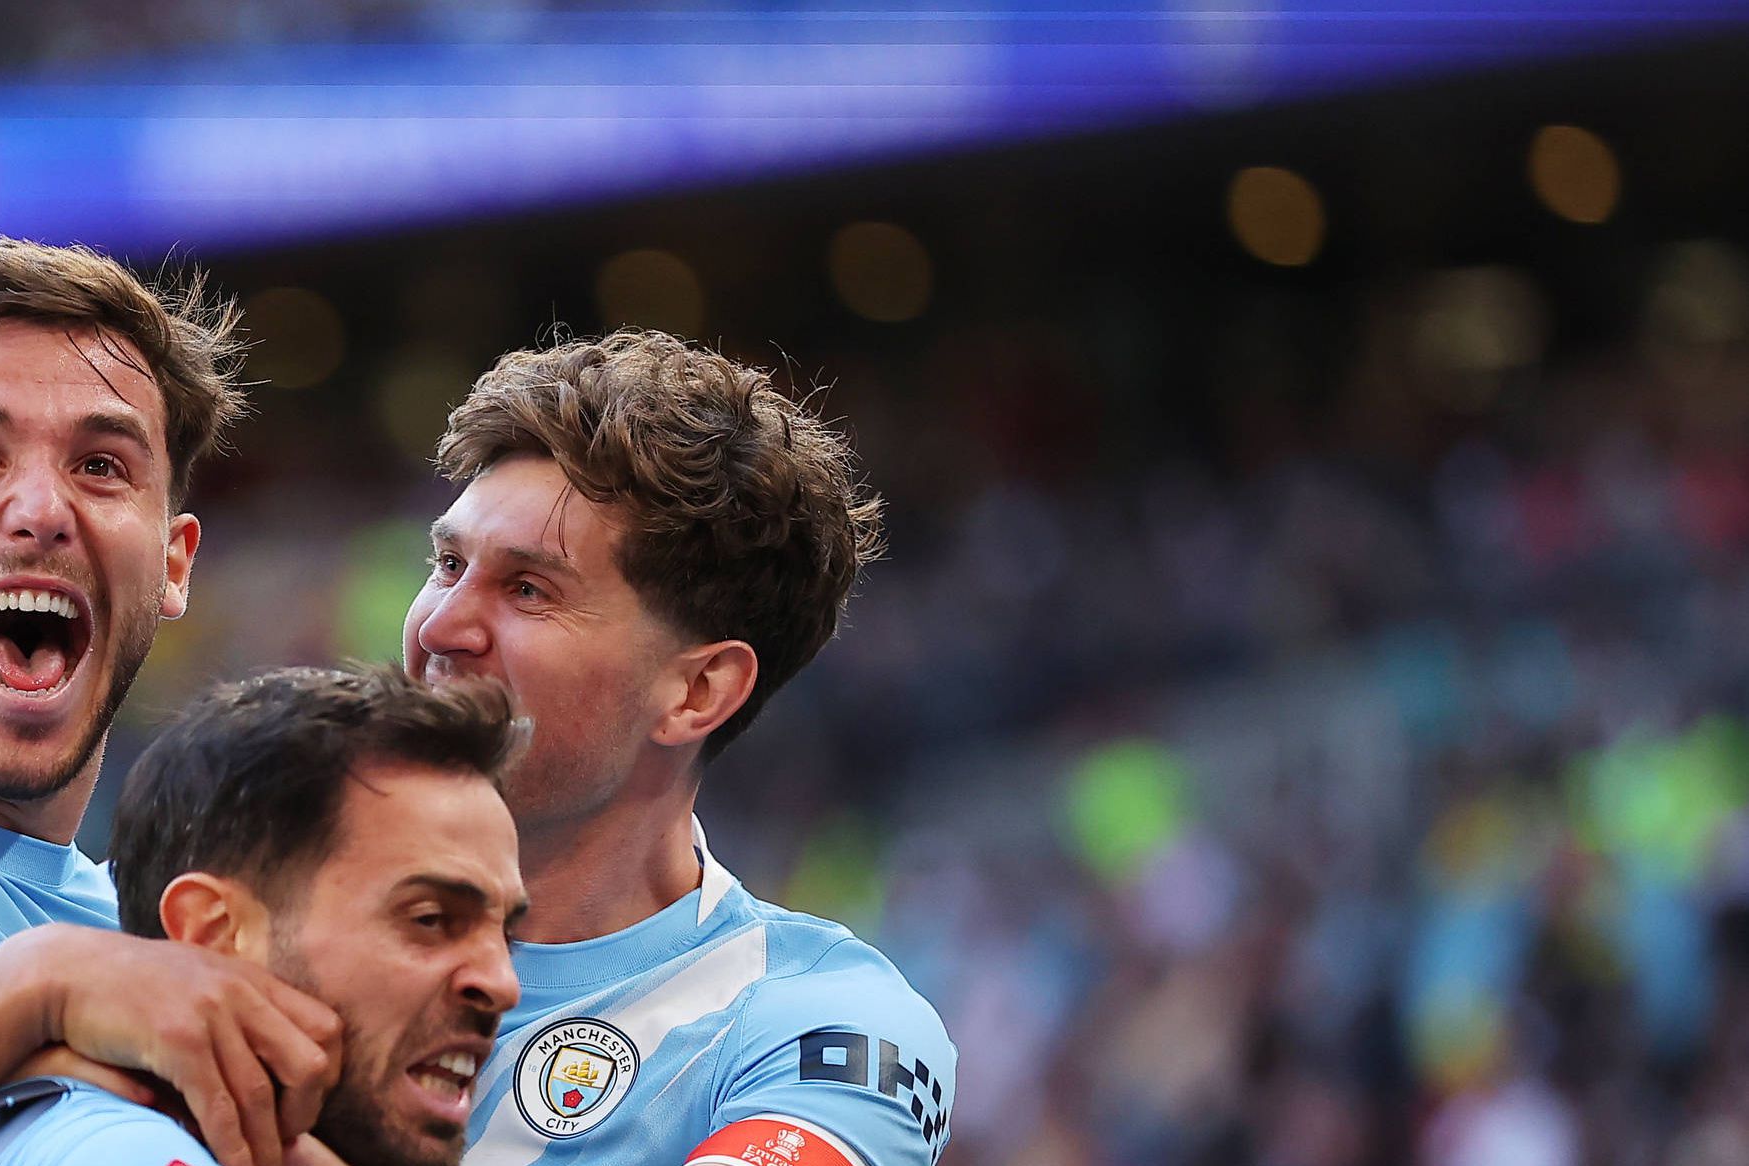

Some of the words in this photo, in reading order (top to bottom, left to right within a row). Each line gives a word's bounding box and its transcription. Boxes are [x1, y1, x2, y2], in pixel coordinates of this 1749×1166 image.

[537, 1027, 631, 1074] MANCHESTER
[546, 1117, 579, 1132] CITY
[741, 1151, 763, 1166] FA
